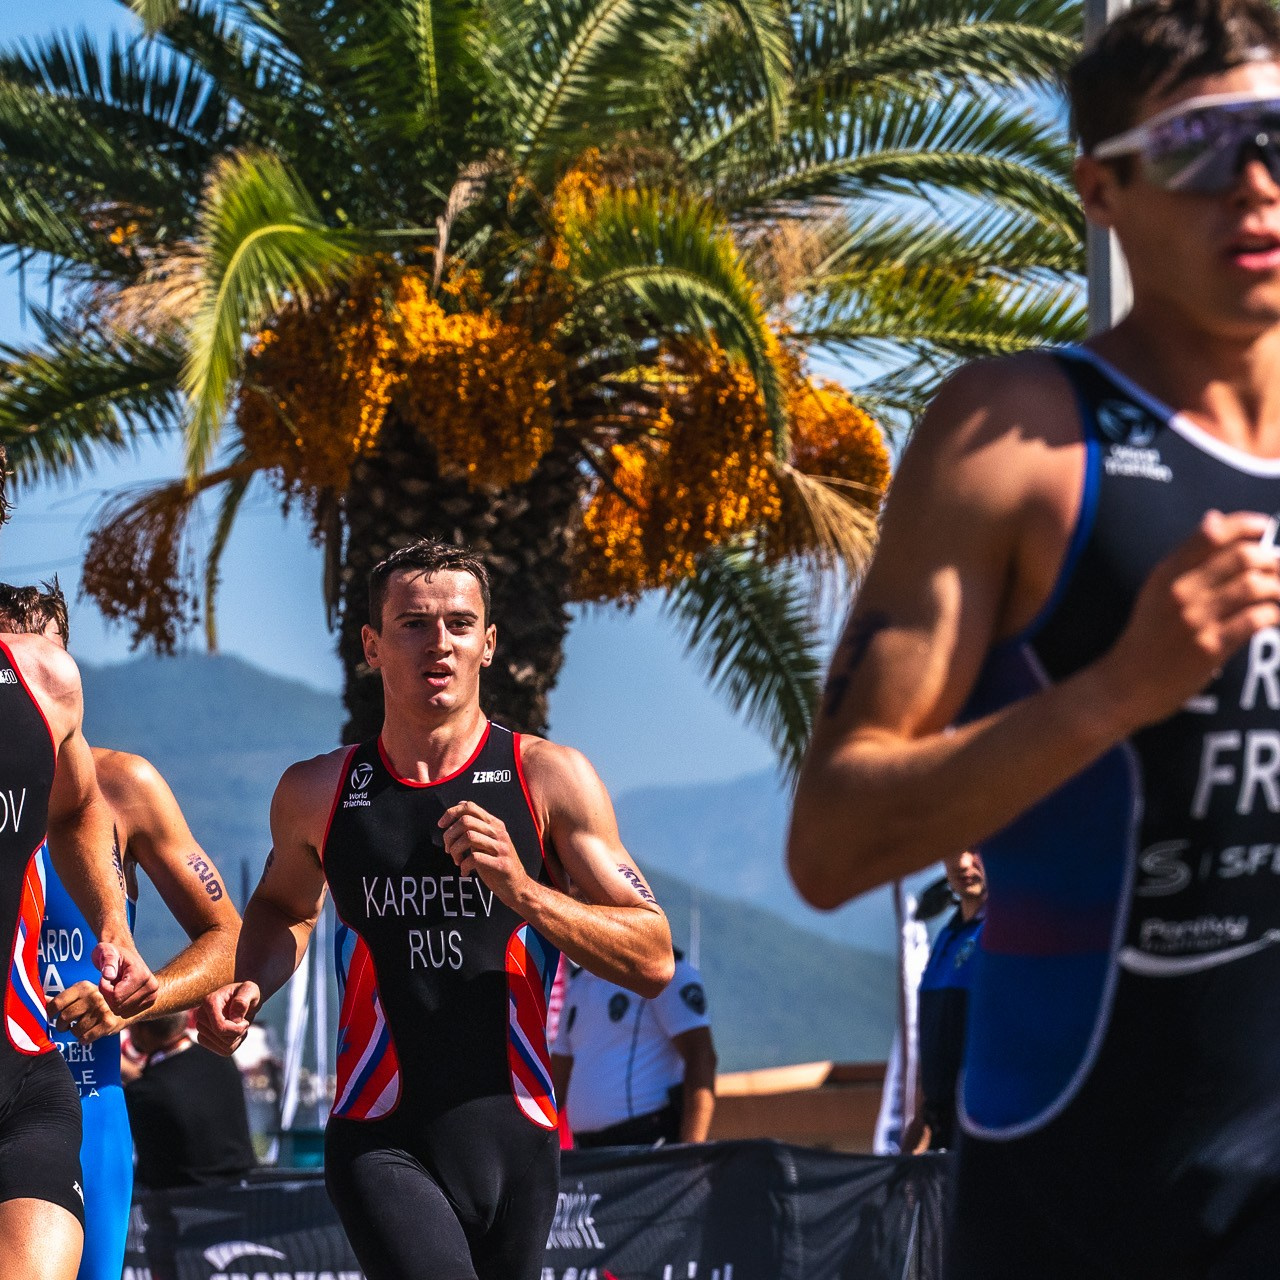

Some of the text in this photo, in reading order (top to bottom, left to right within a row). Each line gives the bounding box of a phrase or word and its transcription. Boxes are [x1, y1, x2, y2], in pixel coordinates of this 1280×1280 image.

[1191, 730, 1280, 819] FR
[343, 799, 371, 809] Triathlon
[349, 792, 368, 801] World
[362, 876, 494, 918] KARPEEV
[408, 930, 463, 970] RUS
